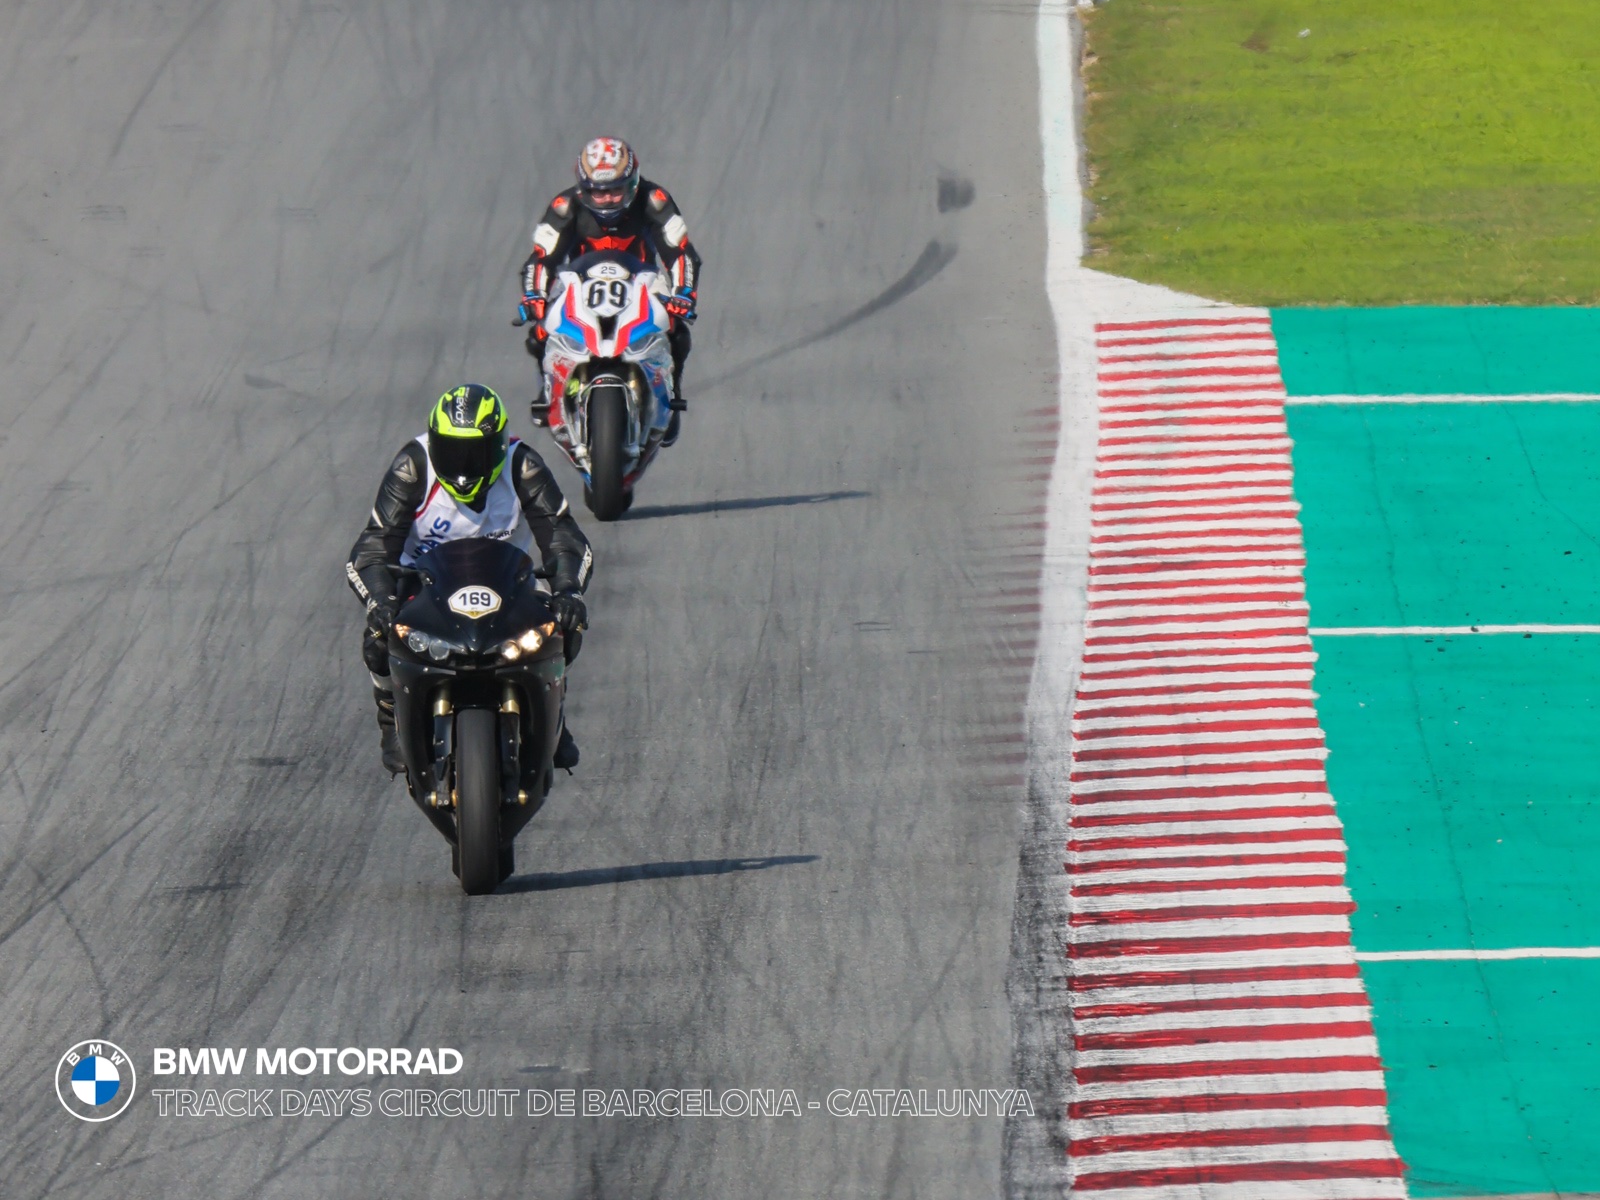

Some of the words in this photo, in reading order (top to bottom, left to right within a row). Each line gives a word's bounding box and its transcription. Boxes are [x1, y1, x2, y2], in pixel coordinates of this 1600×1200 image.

[586, 138, 623, 168] 93
[601, 266, 617, 275] 25
[587, 280, 628, 309] 69
[458, 592, 491, 607] 169
